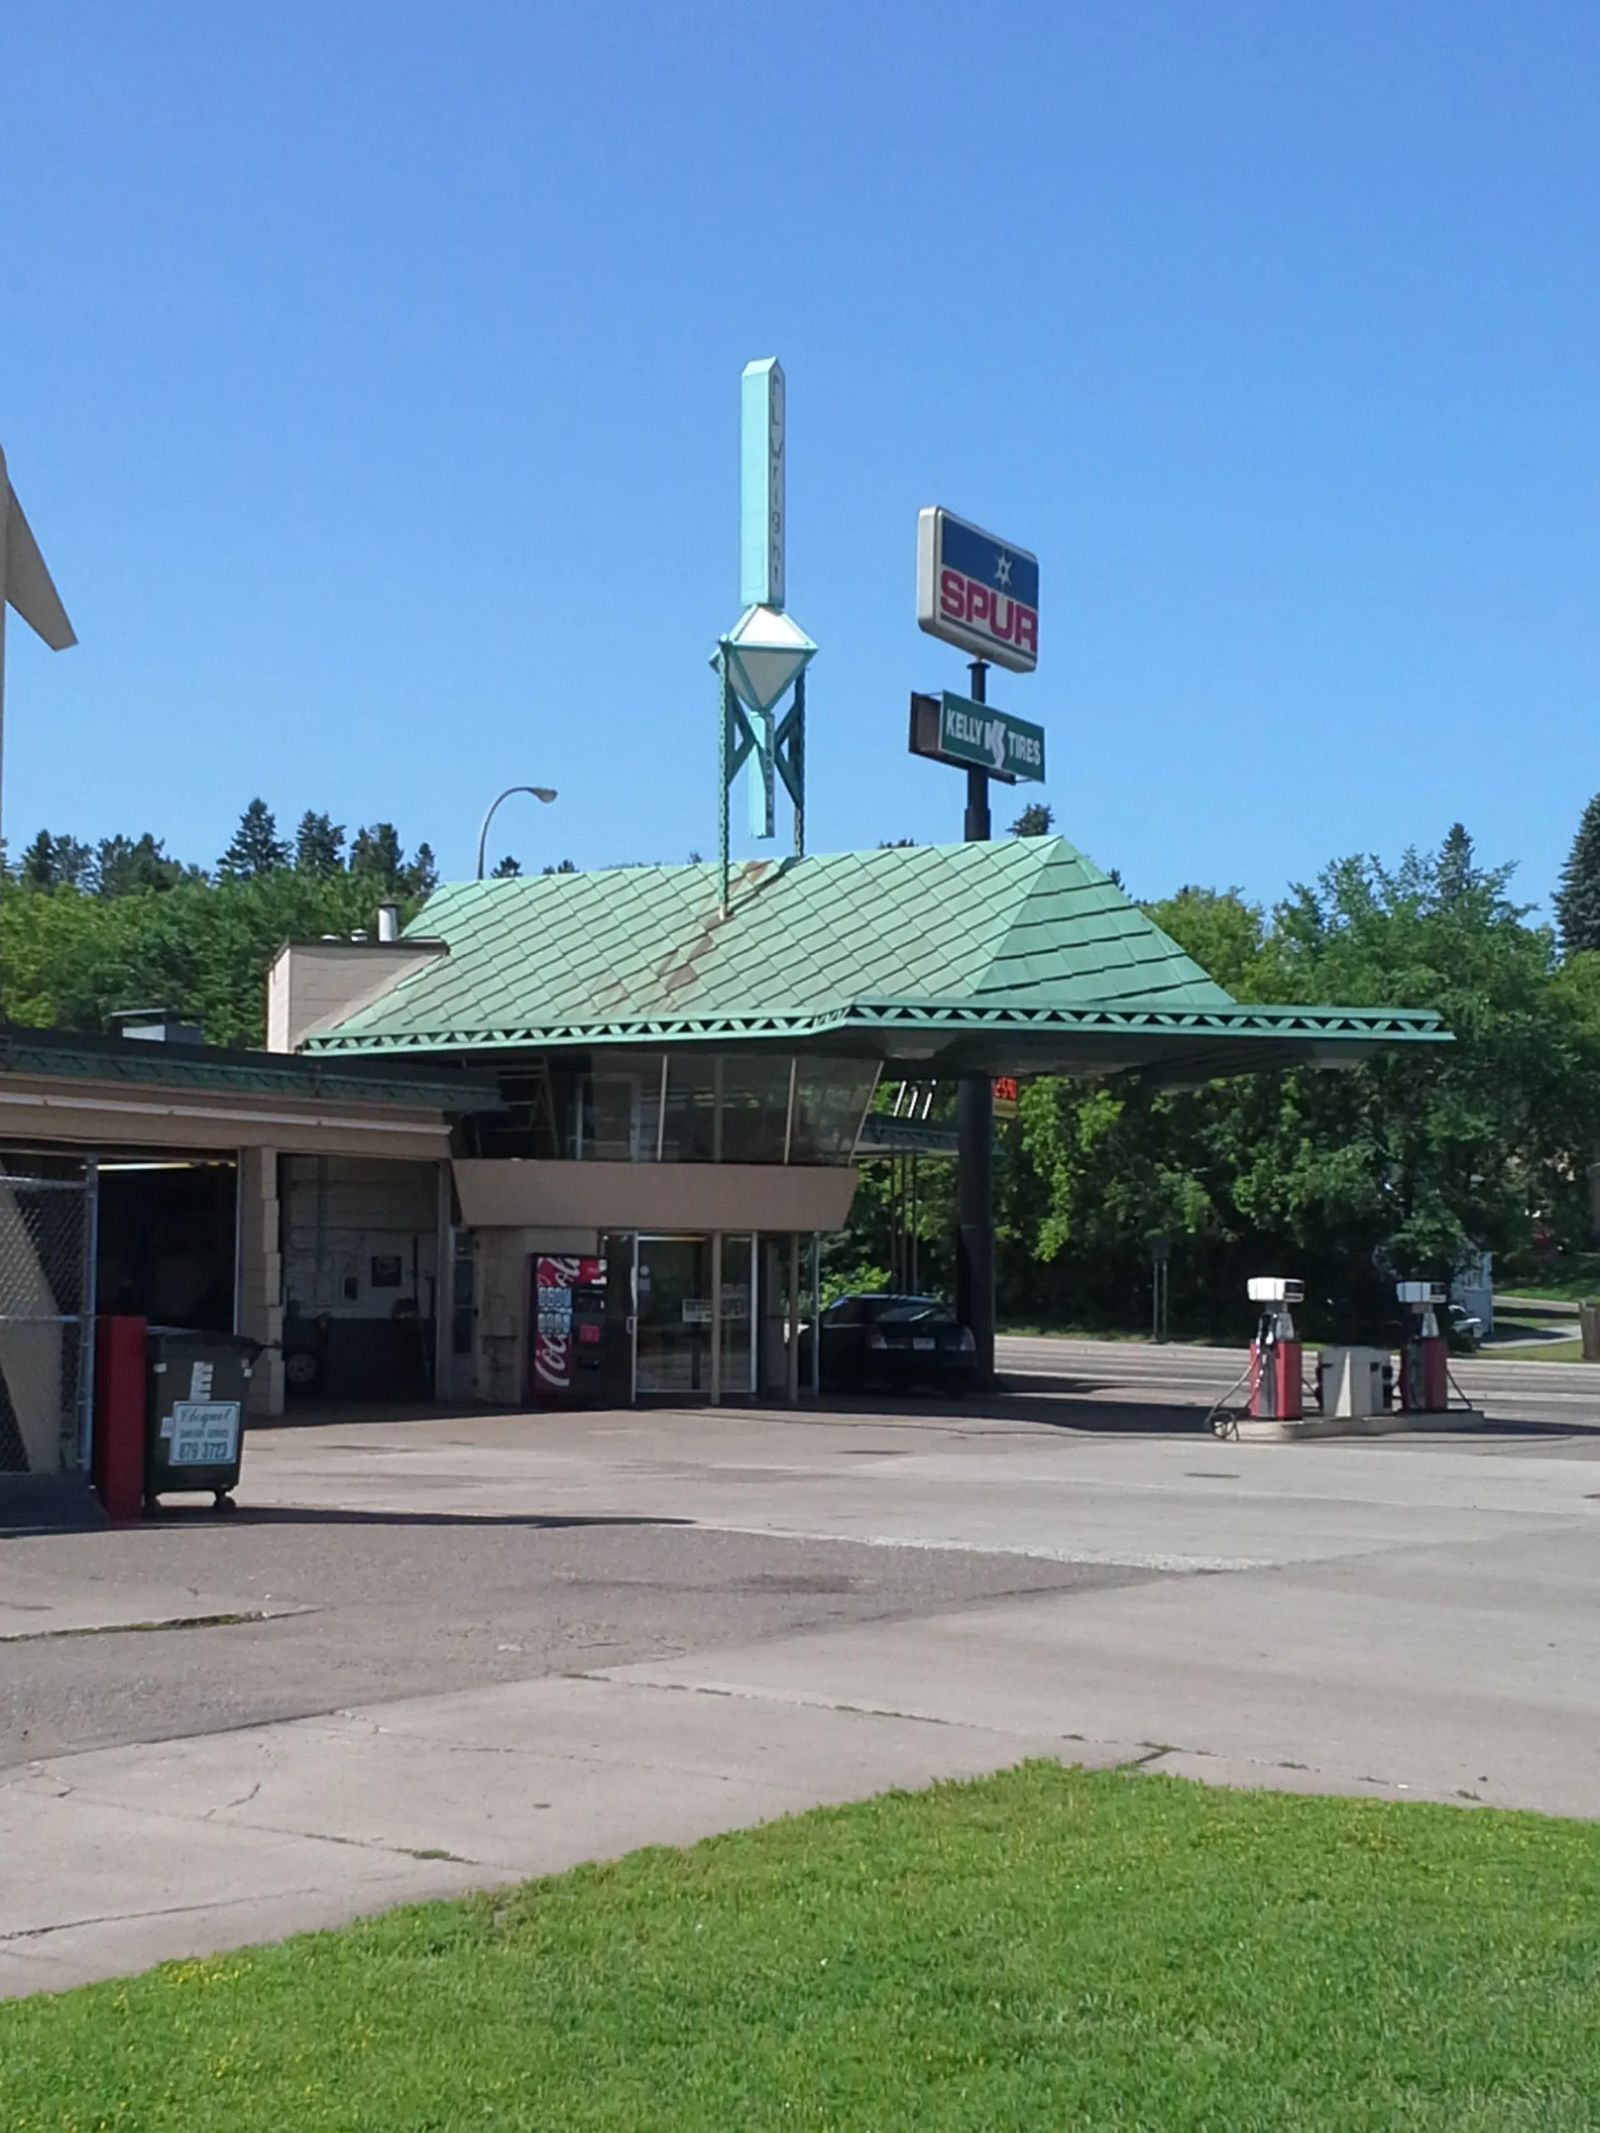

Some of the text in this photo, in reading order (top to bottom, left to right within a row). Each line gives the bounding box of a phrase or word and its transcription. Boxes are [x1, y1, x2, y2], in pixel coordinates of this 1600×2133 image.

[940, 569, 1038, 654] SPUR
[945, 708, 984, 747] KELLY
[1007, 731, 1041, 767] TIRES
